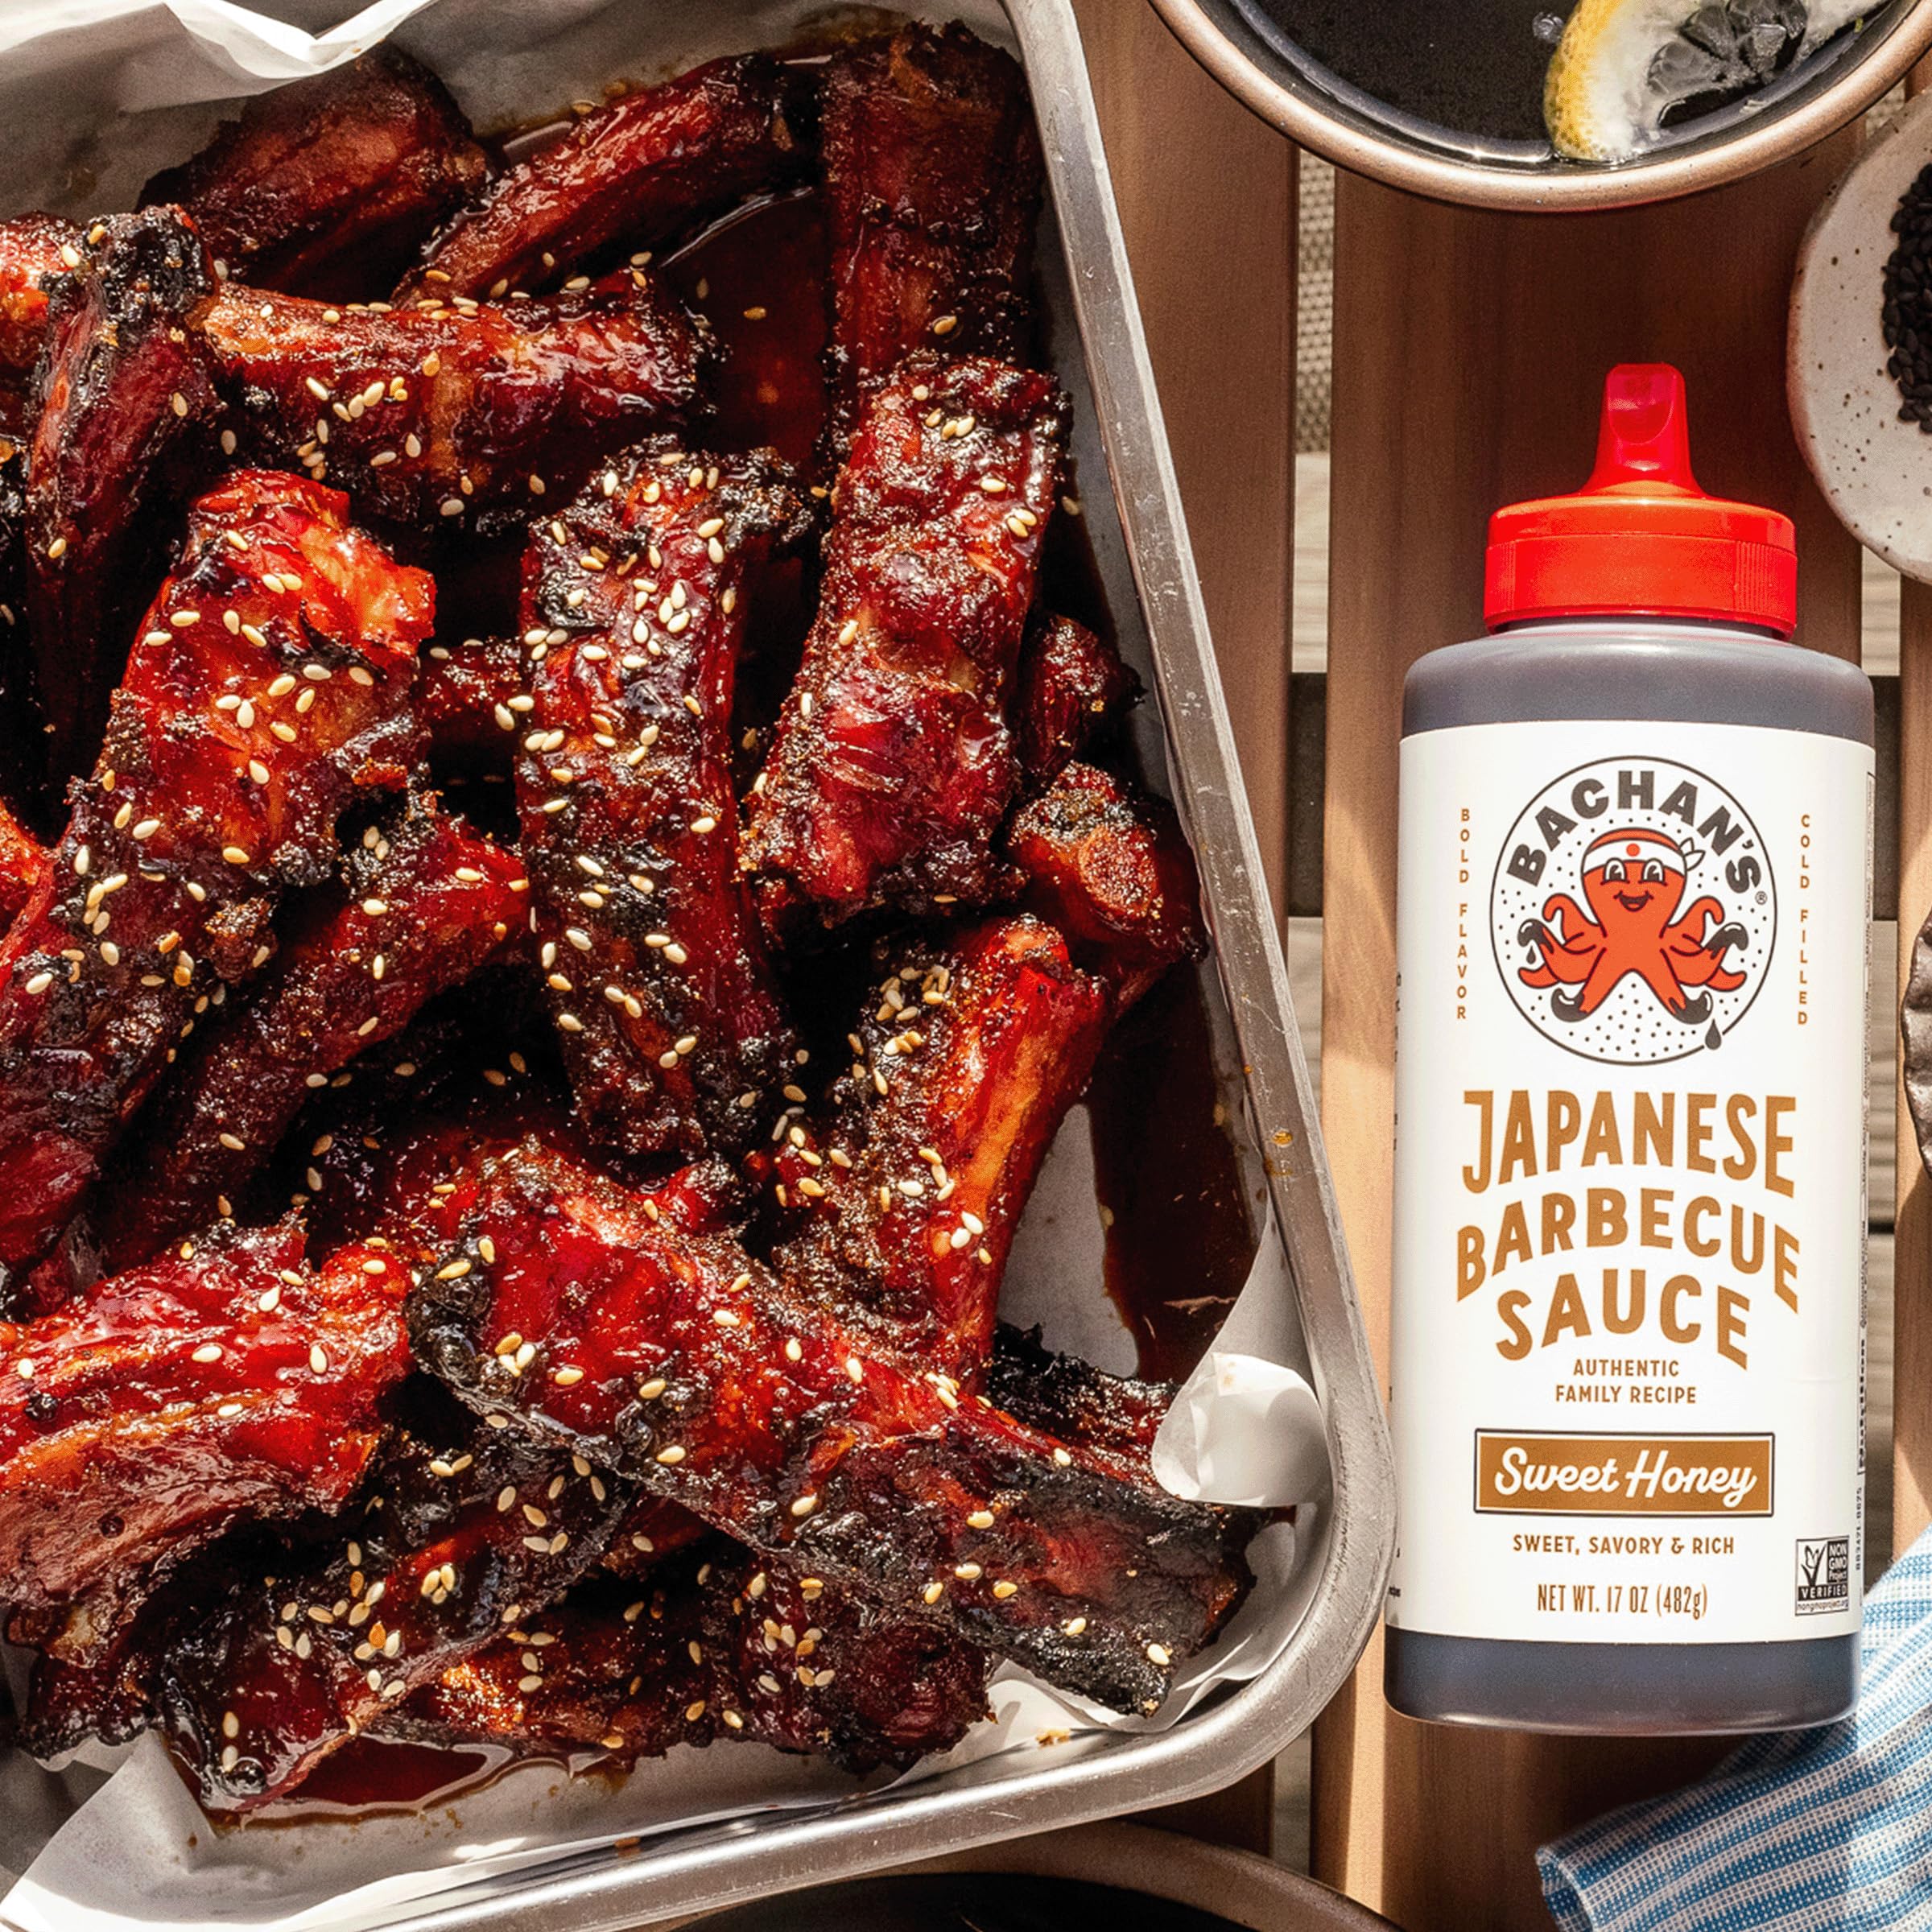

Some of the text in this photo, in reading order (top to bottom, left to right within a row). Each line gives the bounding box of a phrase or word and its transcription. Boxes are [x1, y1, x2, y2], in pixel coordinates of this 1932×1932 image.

[1506, 770, 1761, 894] BACHAN'S
[1457, 808, 1471, 1021] BOLD FLAVOR
[1798, 814, 1811, 1026] COLD FILLED
[1462, 1089, 1798, 1199] JAPANESE
[1456, 1187, 1801, 1315] BARBECUE
[1495, 1268, 1750, 1371] SAUCE
[1573, 1359, 1680, 1377] AUTHENTIC
[1555, 1385, 1697, 1405] FAMILY RECIPE
[1494, 1446, 1758, 1509] Sweet Honey
[1513, 1534, 1736, 1557] SWEET, SAVORY & RICH
[1828, 1543, 1847, 1557] NON
[1828, 1557, 1847, 1570] GMO
[1538, 1583, 1709, 1620] NET WT. 17 OZ (482g)
[1800, 1584, 1848, 1600] VERIFIED
